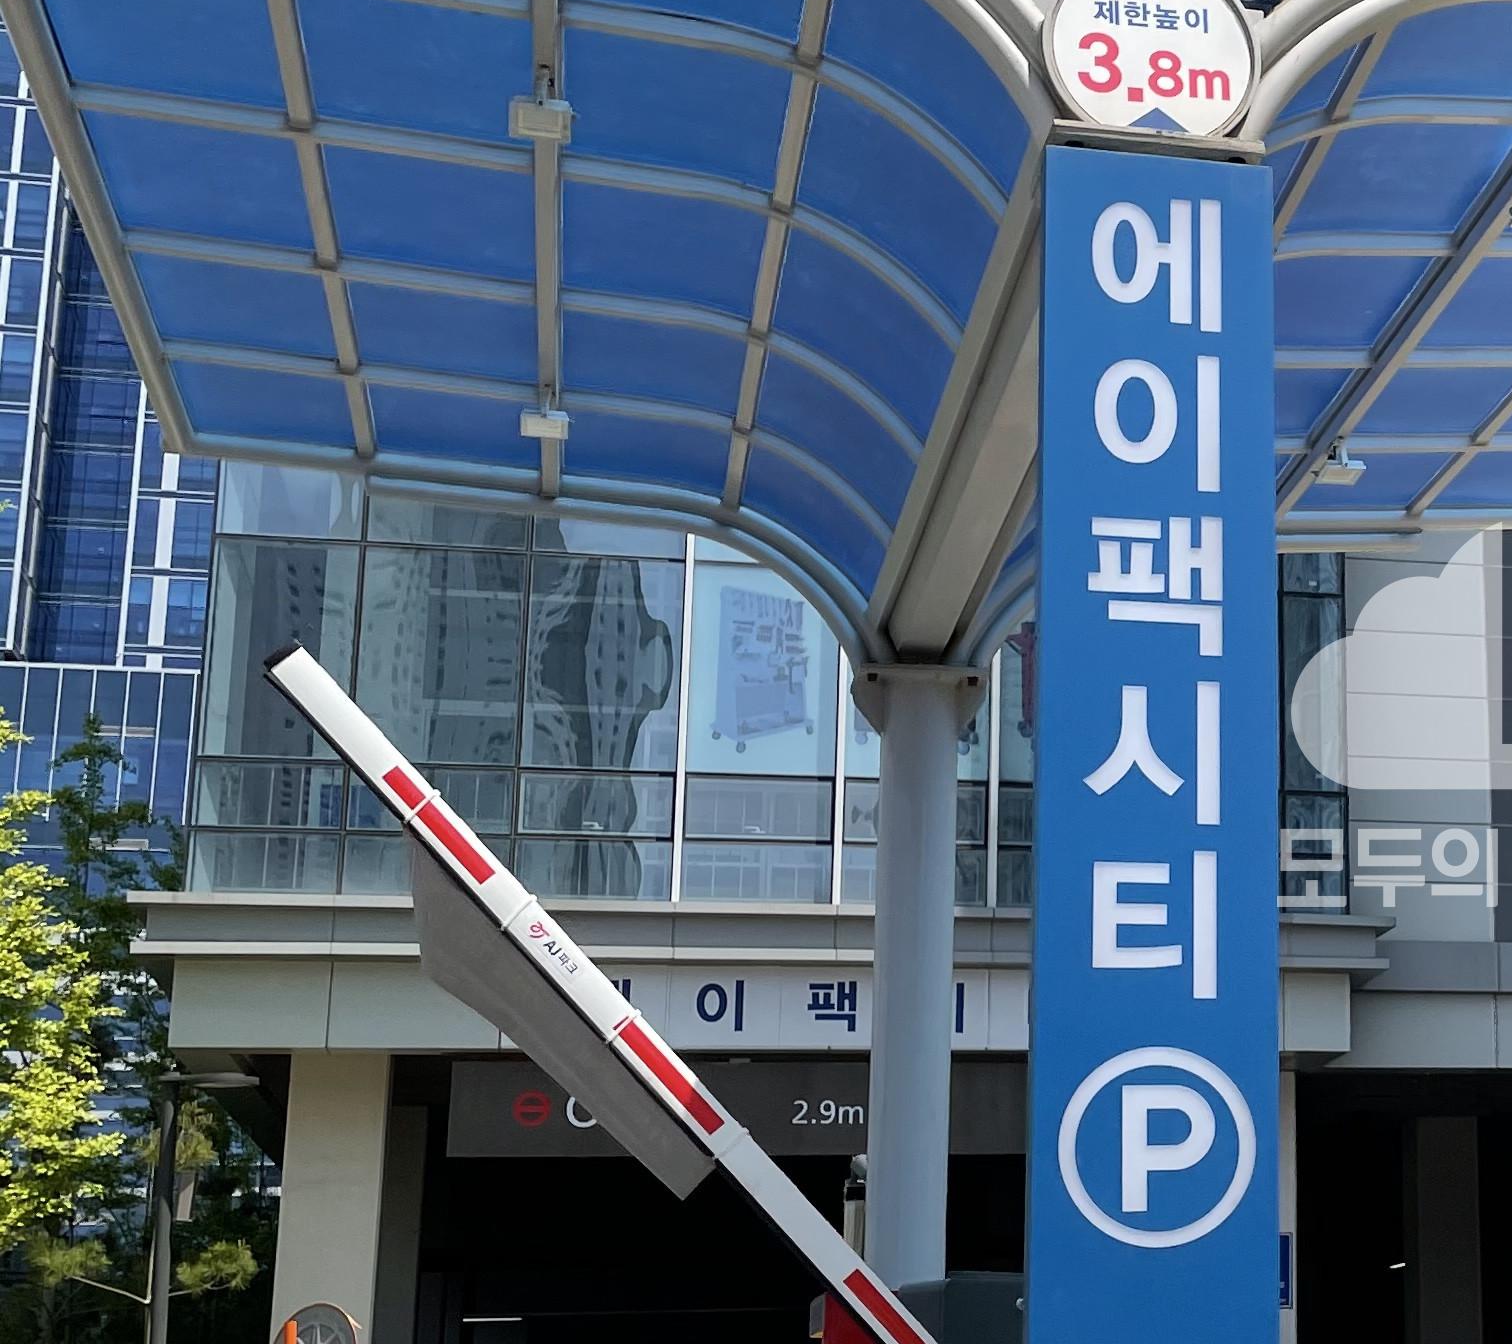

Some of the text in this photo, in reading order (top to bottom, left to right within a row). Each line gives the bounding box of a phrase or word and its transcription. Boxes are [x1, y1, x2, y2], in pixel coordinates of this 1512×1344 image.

[1093, 0, 1209, 34] 제한높이
[1077, 32, 1231, 103] 3.8m
[1082, 198, 1224, 999] 에이팩시티
[791, 1099, 864, 1125] 2.9m
